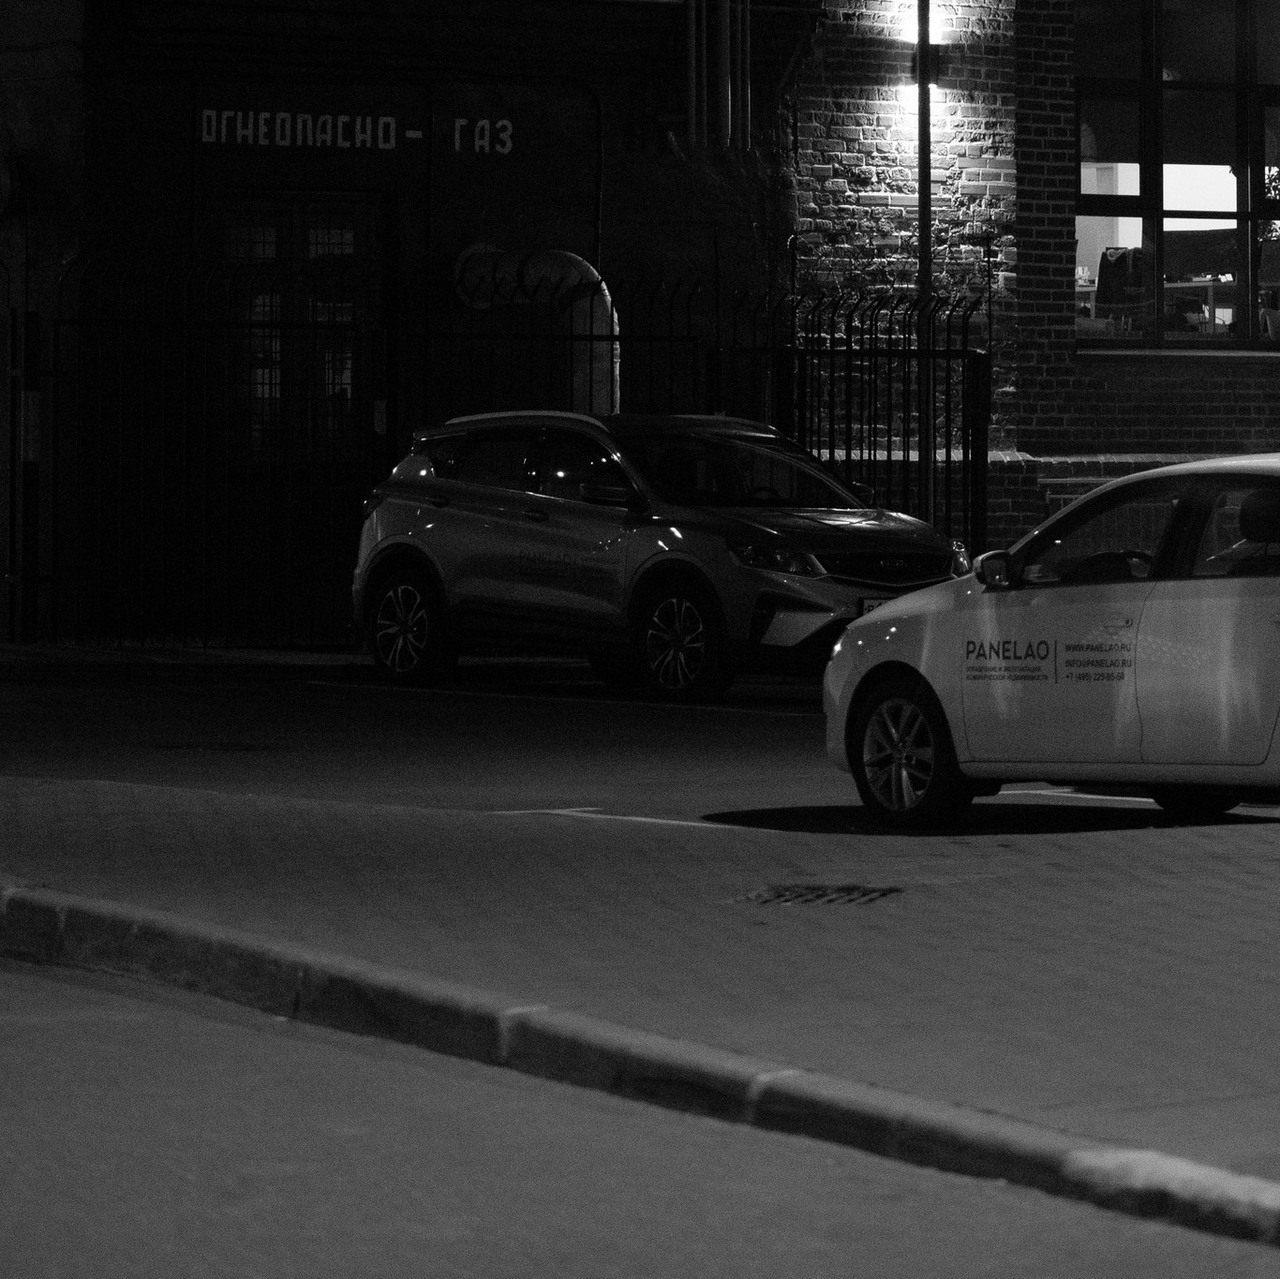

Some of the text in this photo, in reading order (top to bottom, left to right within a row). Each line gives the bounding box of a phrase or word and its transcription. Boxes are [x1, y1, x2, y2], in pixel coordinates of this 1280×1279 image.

[454, 117, 514, 154] ГАЗ
[966, 640, 1049, 660] PANELAO
[1065, 644, 1132, 652] WWW.PANELAO.RU
